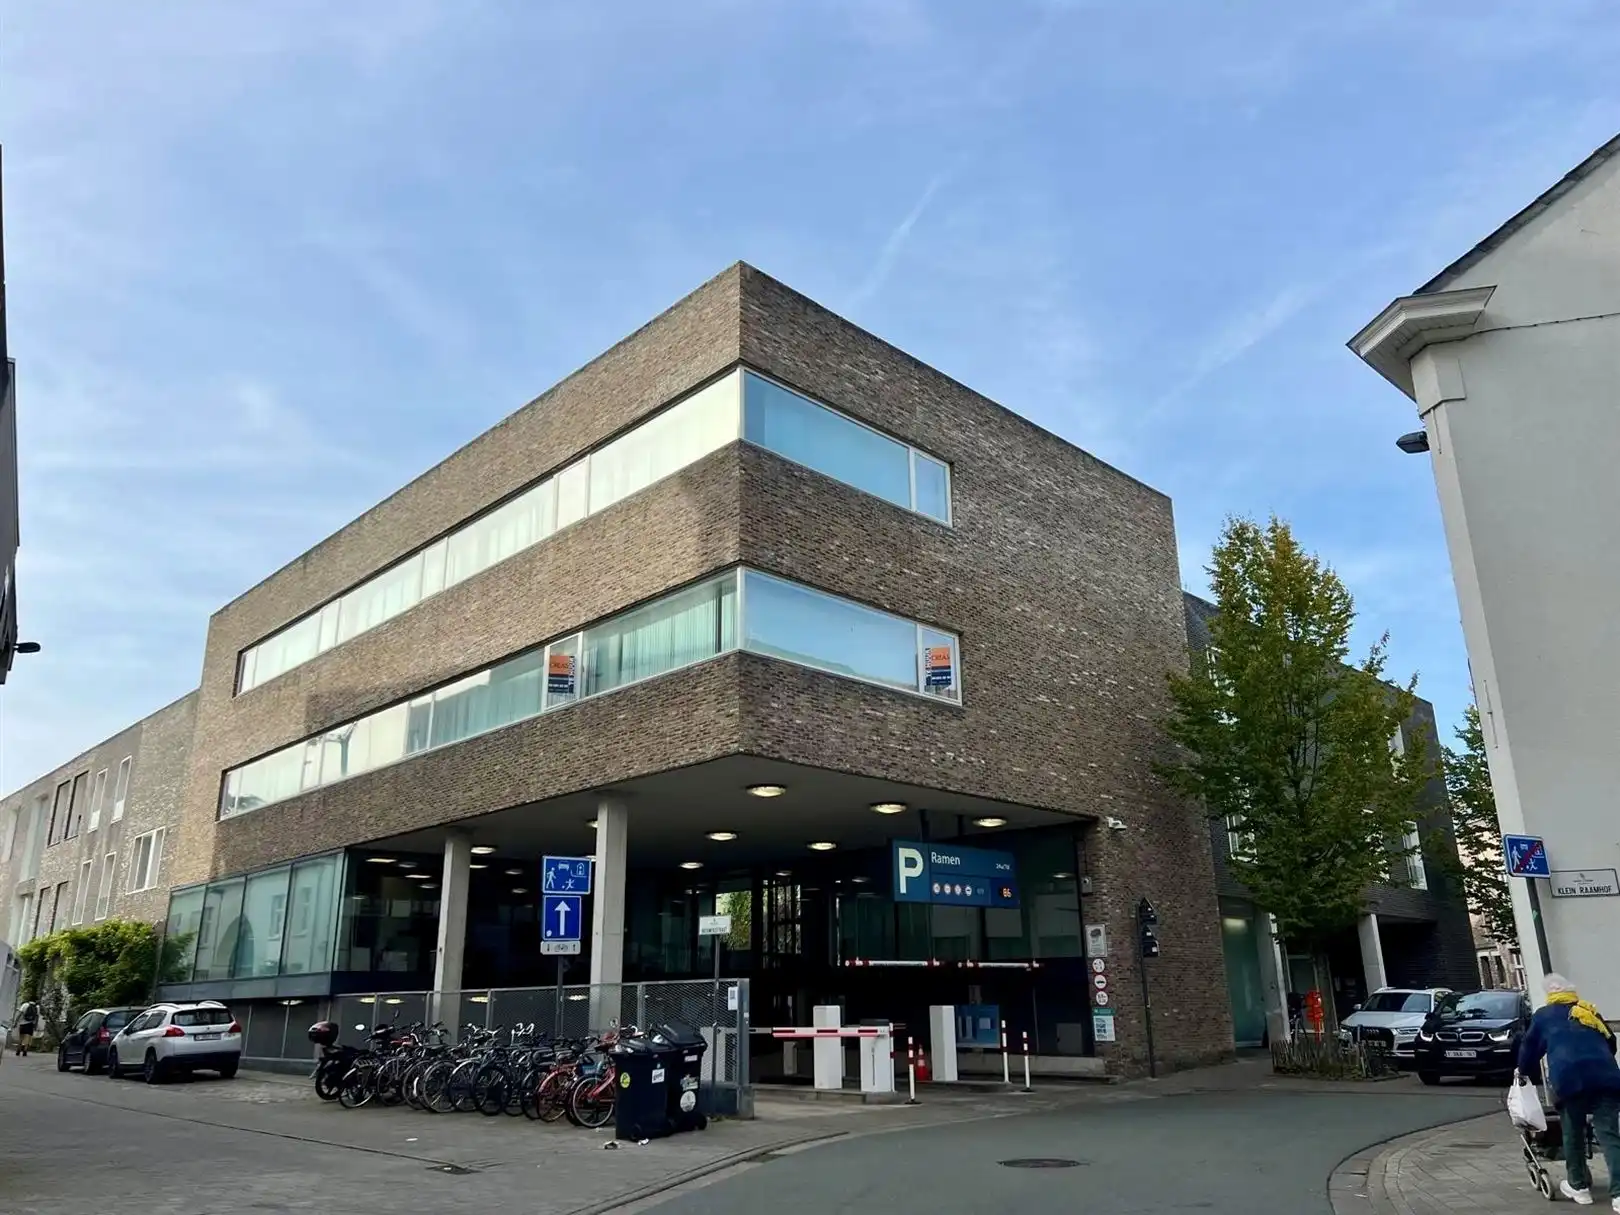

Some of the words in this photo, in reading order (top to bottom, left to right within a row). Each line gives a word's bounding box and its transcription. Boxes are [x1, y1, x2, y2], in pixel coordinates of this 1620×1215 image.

[931, 851, 961, 866] Ramen
[898, 847, 924, 894] P
[1557, 887, 1577, 895] KLEIN
[1579, 885, 1612, 894] RAAMHOF
